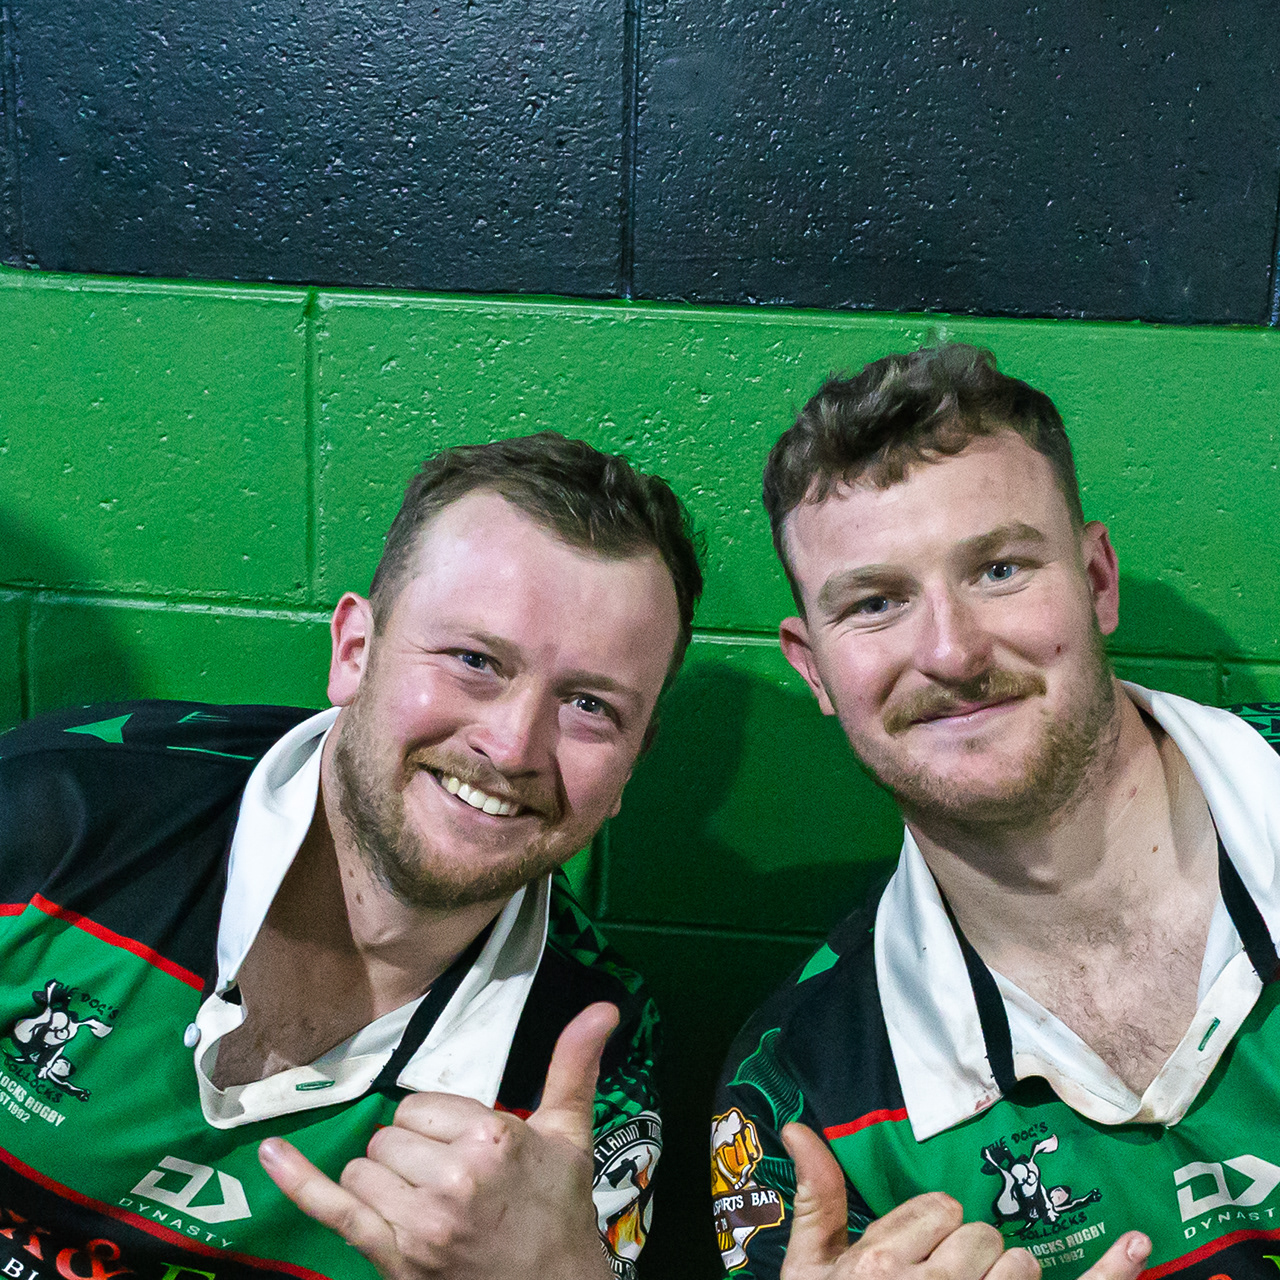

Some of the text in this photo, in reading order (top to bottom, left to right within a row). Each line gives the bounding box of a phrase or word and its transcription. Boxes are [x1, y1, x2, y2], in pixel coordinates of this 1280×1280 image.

[7, 1100, 32, 1125] 1992
[24, 1095, 67, 1128] RUGBY
[1011, 1121, 1049, 1145] DOG'S
[750, 1189, 780, 1207] BAR
[117, 1196, 235, 1249] DYNASTY
[1023, 1221, 1107, 1257] LOCKS RUGBY
[1039, 1256, 1057, 1269] EST
